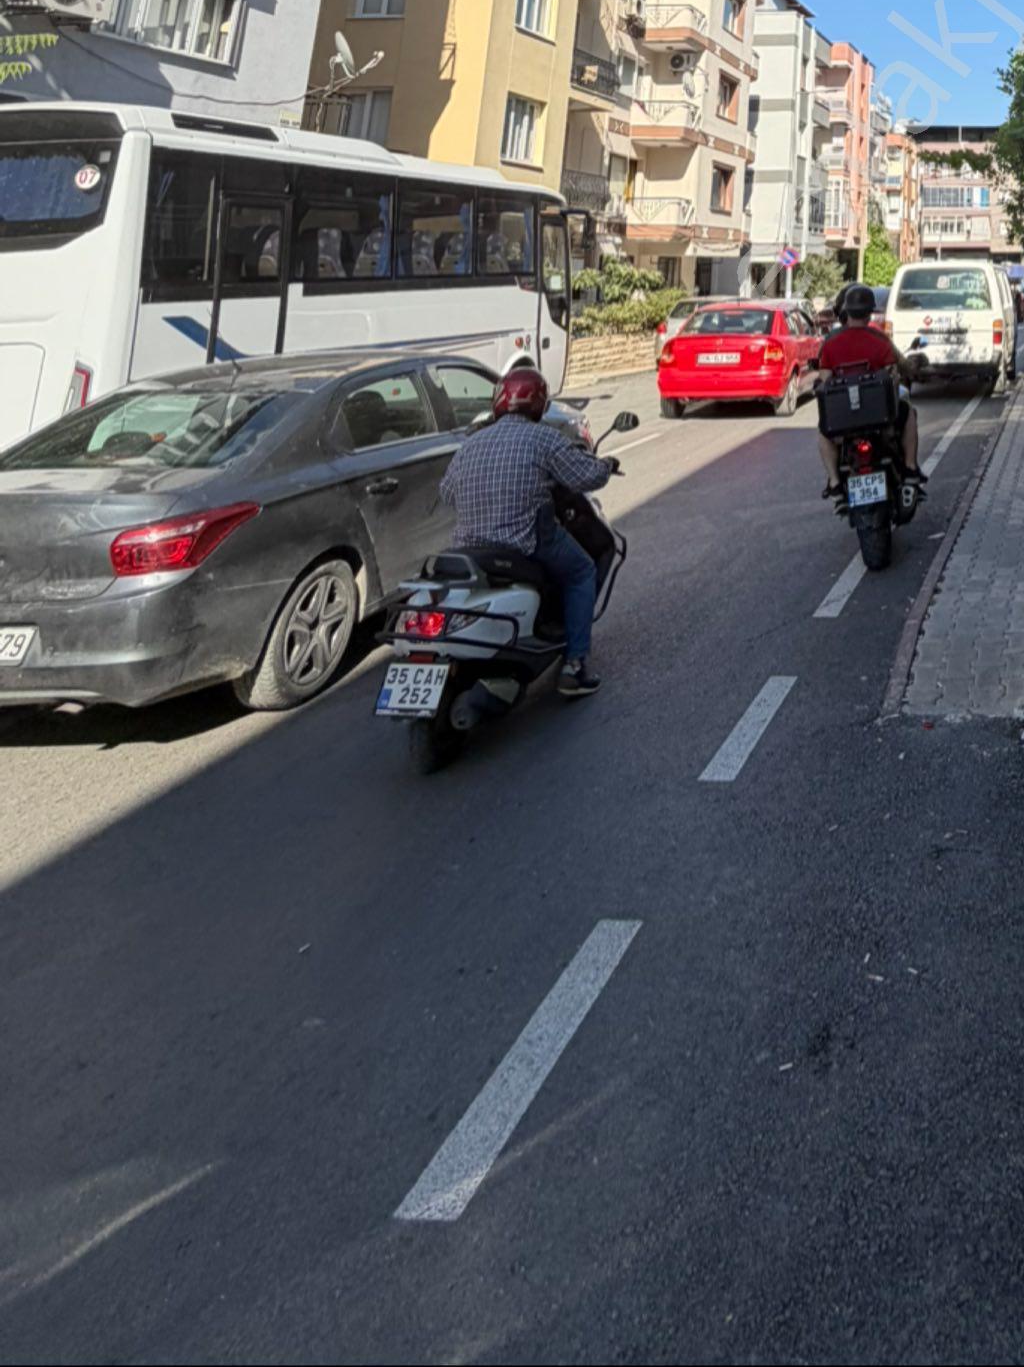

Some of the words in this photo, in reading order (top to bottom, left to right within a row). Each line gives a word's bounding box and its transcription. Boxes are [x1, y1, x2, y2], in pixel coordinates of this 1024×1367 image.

[79, 171, 97, 184] 07
[0, 633, 27, 657] 79
[387, 667, 410, 684] 35
[413, 668, 447, 686] CAH
[398, 687, 433, 705] 252
